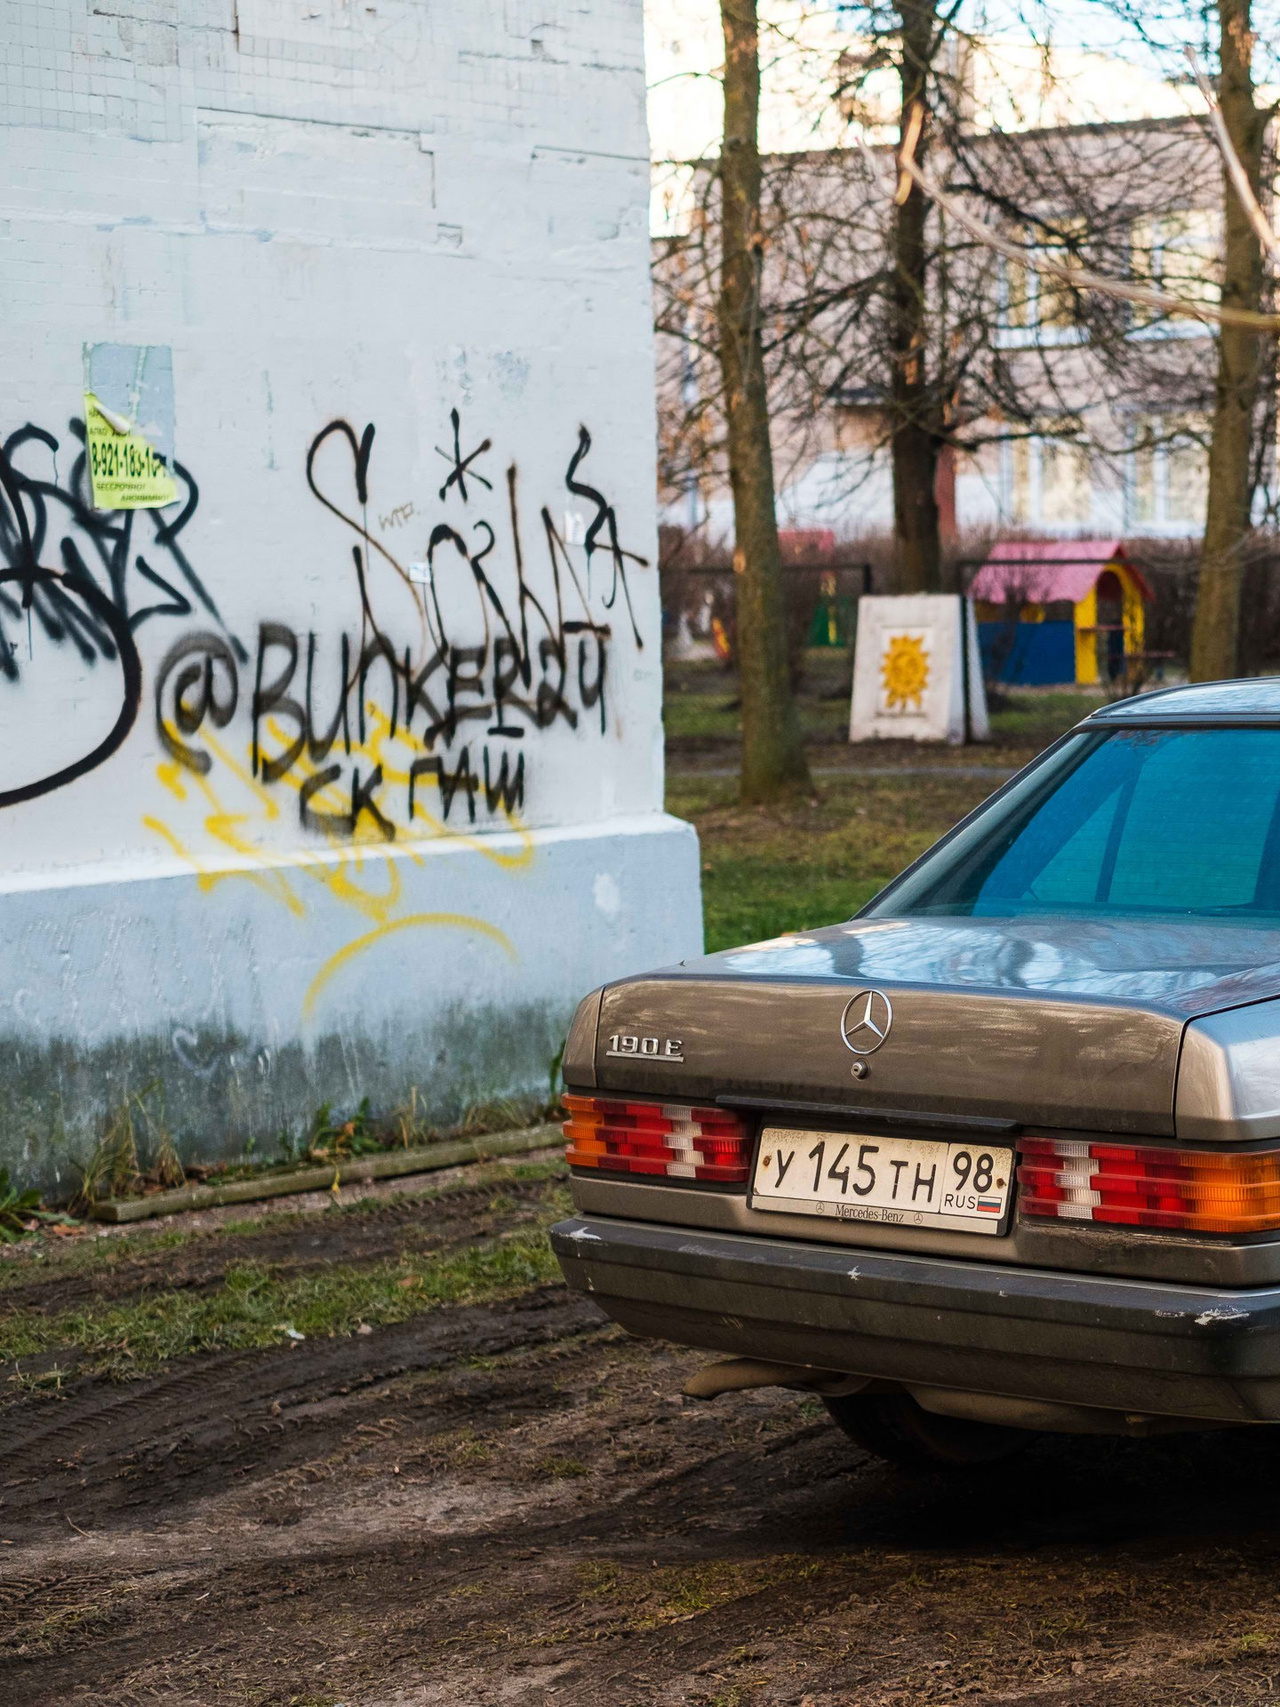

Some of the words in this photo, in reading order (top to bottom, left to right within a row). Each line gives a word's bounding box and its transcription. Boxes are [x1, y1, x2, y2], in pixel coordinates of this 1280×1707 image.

[609, 1034, 658, 1055] 190
[665, 1039, 683, 1056] E
[808, 1141, 880, 1196] 145
[953, 1151, 994, 1193] 98
[944, 1193, 976, 1210] RUS
[835, 1204, 904, 1223] Mercedes-Benz
